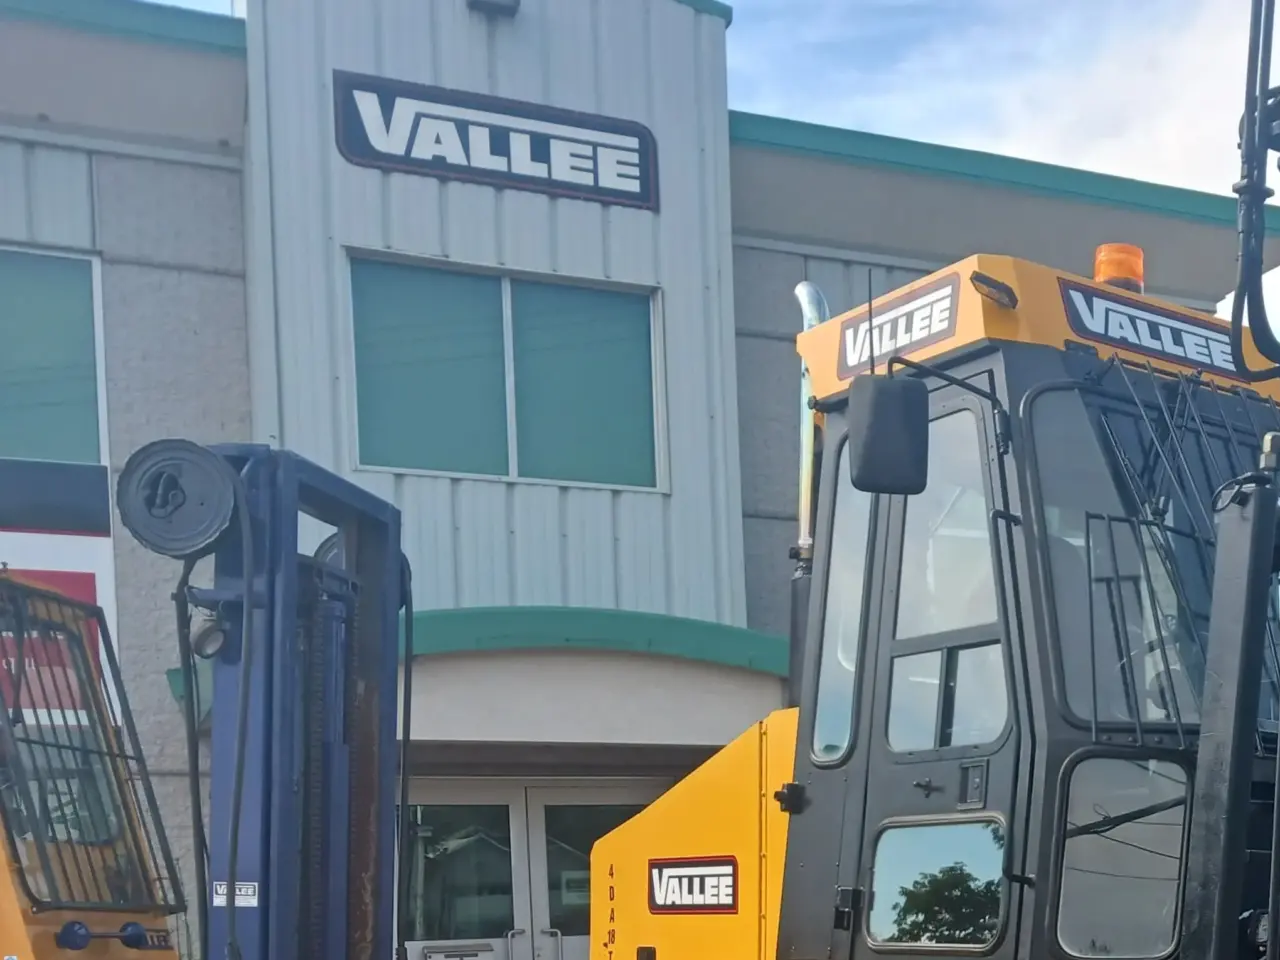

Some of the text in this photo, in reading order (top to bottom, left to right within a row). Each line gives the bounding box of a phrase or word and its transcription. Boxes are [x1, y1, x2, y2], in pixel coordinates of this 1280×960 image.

[352, 89, 641, 193] VALLEE
[845, 285, 953, 368] VALLEE
[1068, 289, 1238, 372] VALLEE
[651, 865, 734, 906] VALLEE
